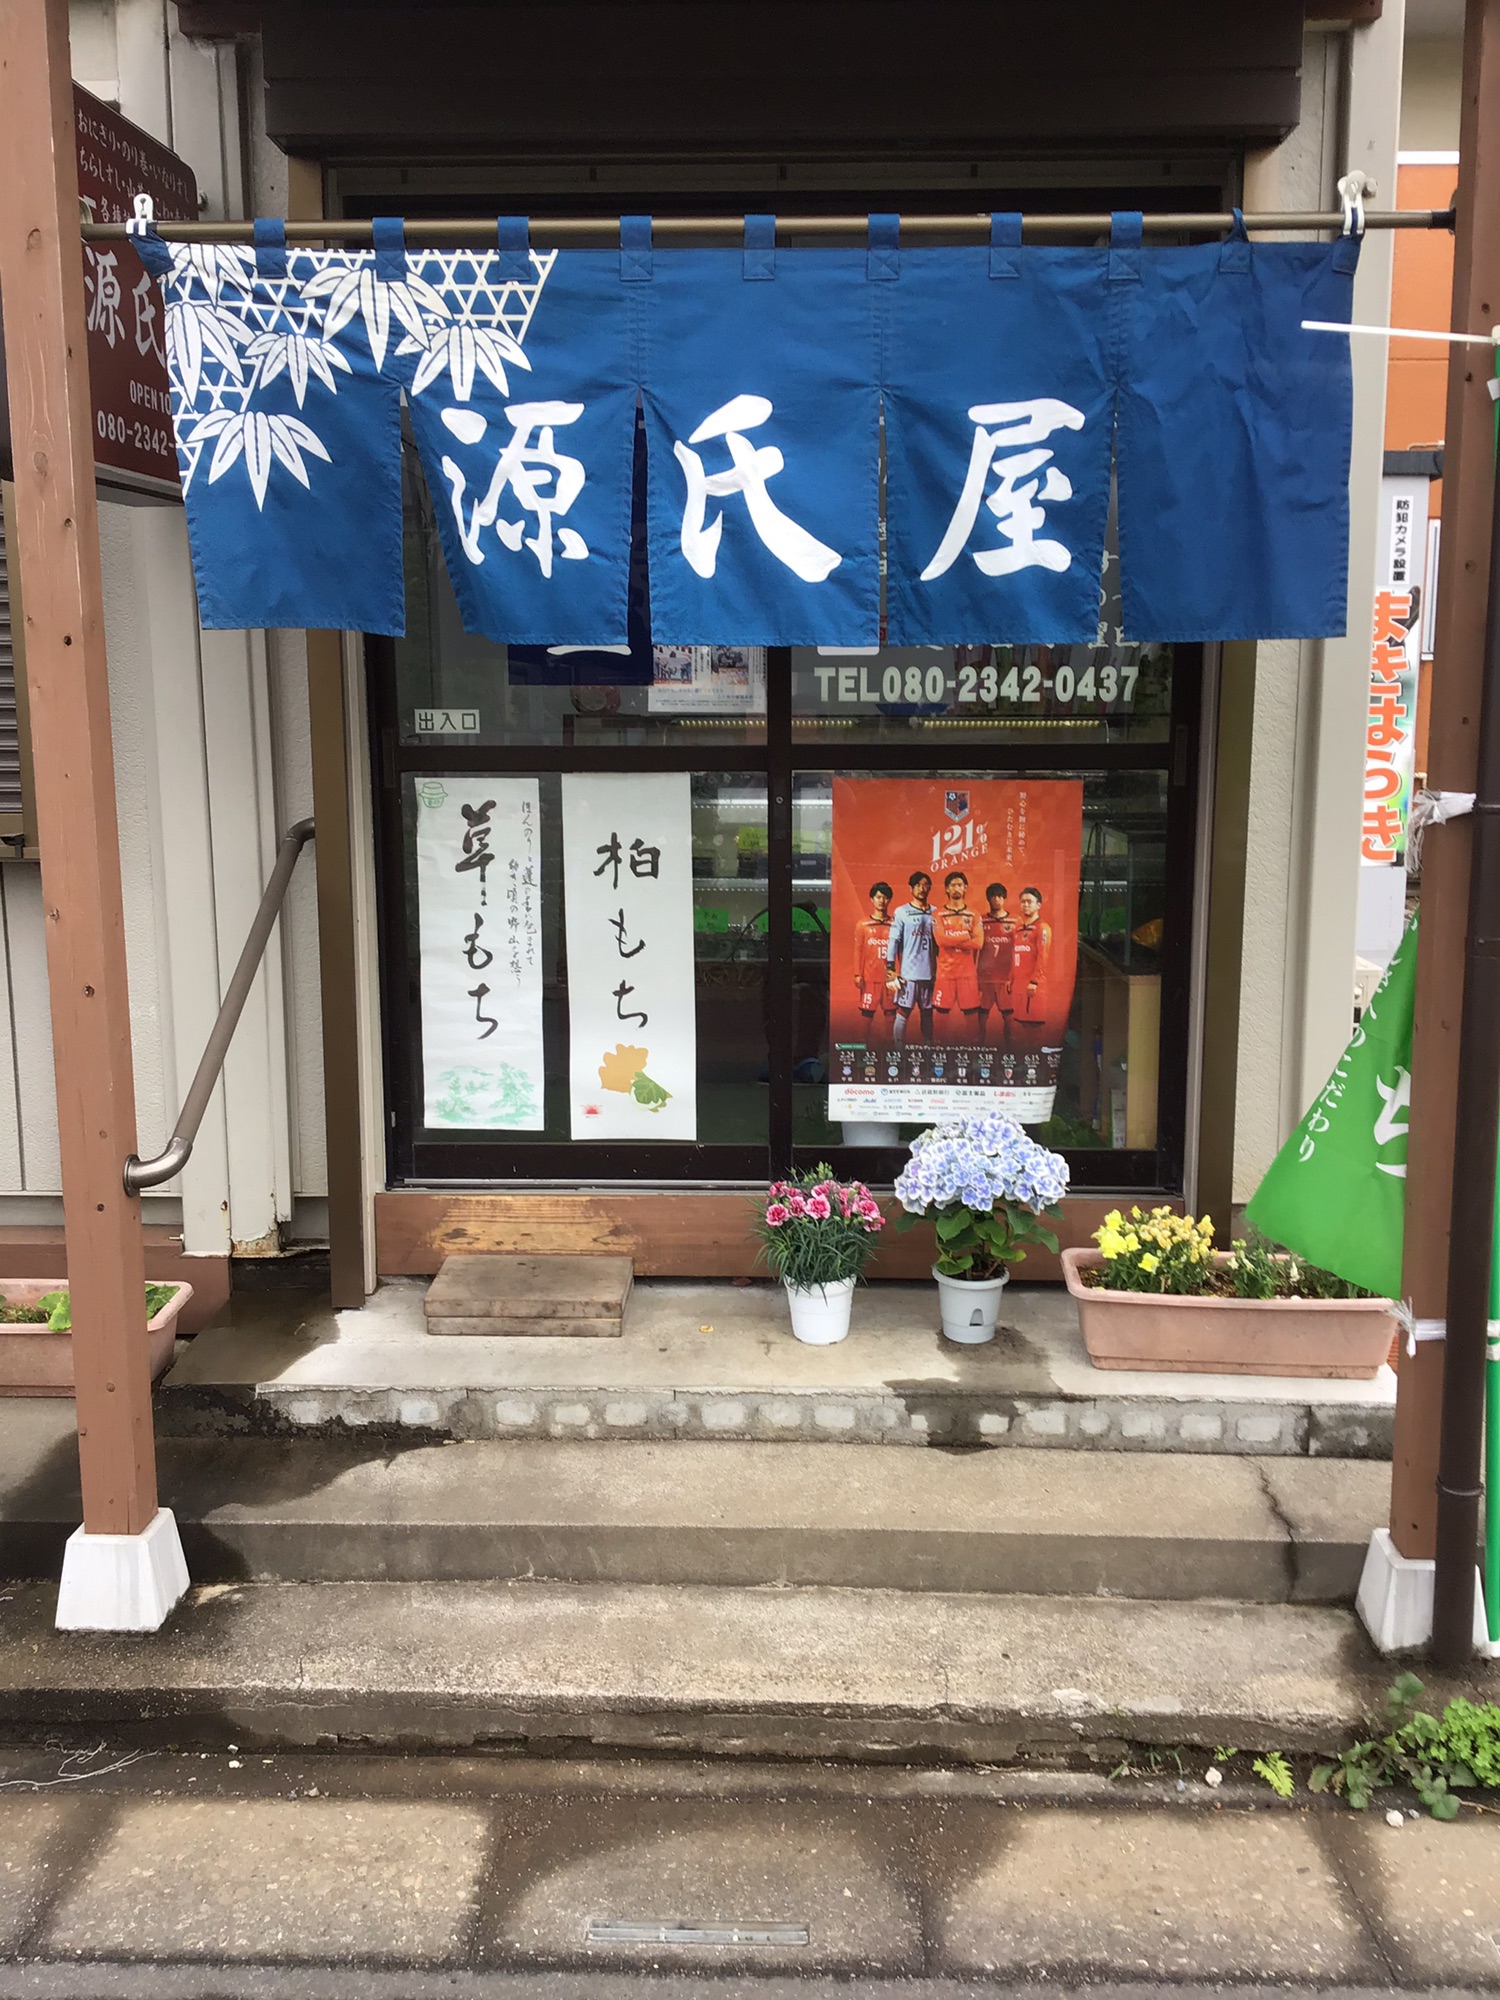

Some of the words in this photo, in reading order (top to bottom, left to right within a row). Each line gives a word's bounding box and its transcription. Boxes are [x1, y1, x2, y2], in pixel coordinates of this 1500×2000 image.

[84, 245, 166, 369] 源氏
[129, 379, 158, 411] OPEN
[97, 410, 175, 457] 080-2342-
[440, 394, 1087, 583] 源氏屋
[1393, 499, 1410, 581] 防犯カメラ設置
[418, 711, 477, 731] 出入口
[930, 843, 989, 873] ORANGE
[931, 818, 989, 862] 121%
[455, 799, 499, 1041] 草もち
[593, 832, 661, 1029] 柏もち
[993, 944, 1000, 958] 7
[863, 993, 873, 1005] 15
[844, 1088, 875, 1096] docomo
